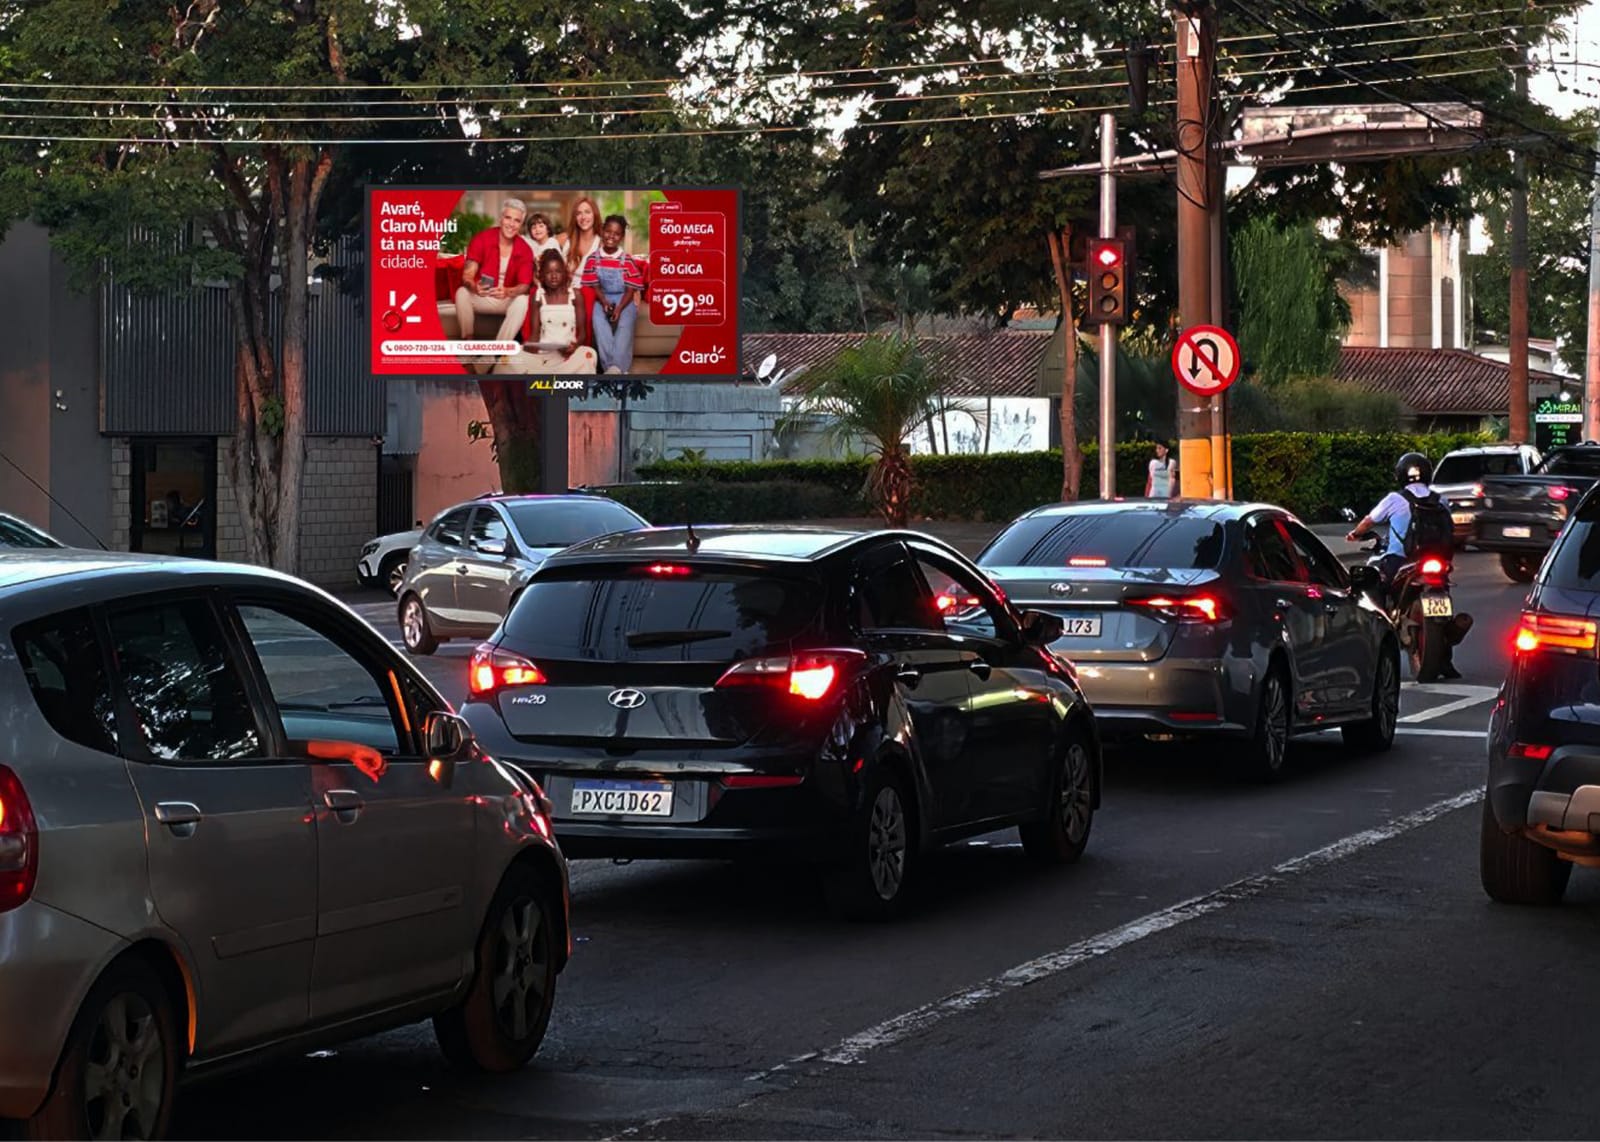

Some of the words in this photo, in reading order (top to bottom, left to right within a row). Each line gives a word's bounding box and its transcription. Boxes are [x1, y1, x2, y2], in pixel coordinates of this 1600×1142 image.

[381, 202, 425, 217] Avaré,
[380, 219, 416, 233] Claro
[419, 219, 458, 233] Multi
[660, 224, 681, 234] 600
[683, 224, 714, 234] MEGA
[380, 237, 394, 251] tá
[397, 239, 414, 251] na
[416, 239, 441, 251] sua
[380, 254, 428, 269] cidade.
[660, 264, 675, 275] 60
[676, 264, 703, 275] GIGA
[662, 293, 714, 317] 99,90
[680, 348, 721, 364] Claro
[529, 380, 553, 390] ALL
[553, 380, 584, 390] DOOR
[1553, 404, 1581, 413] MIRAI
[581, 790, 663, 812] PXC1D62
